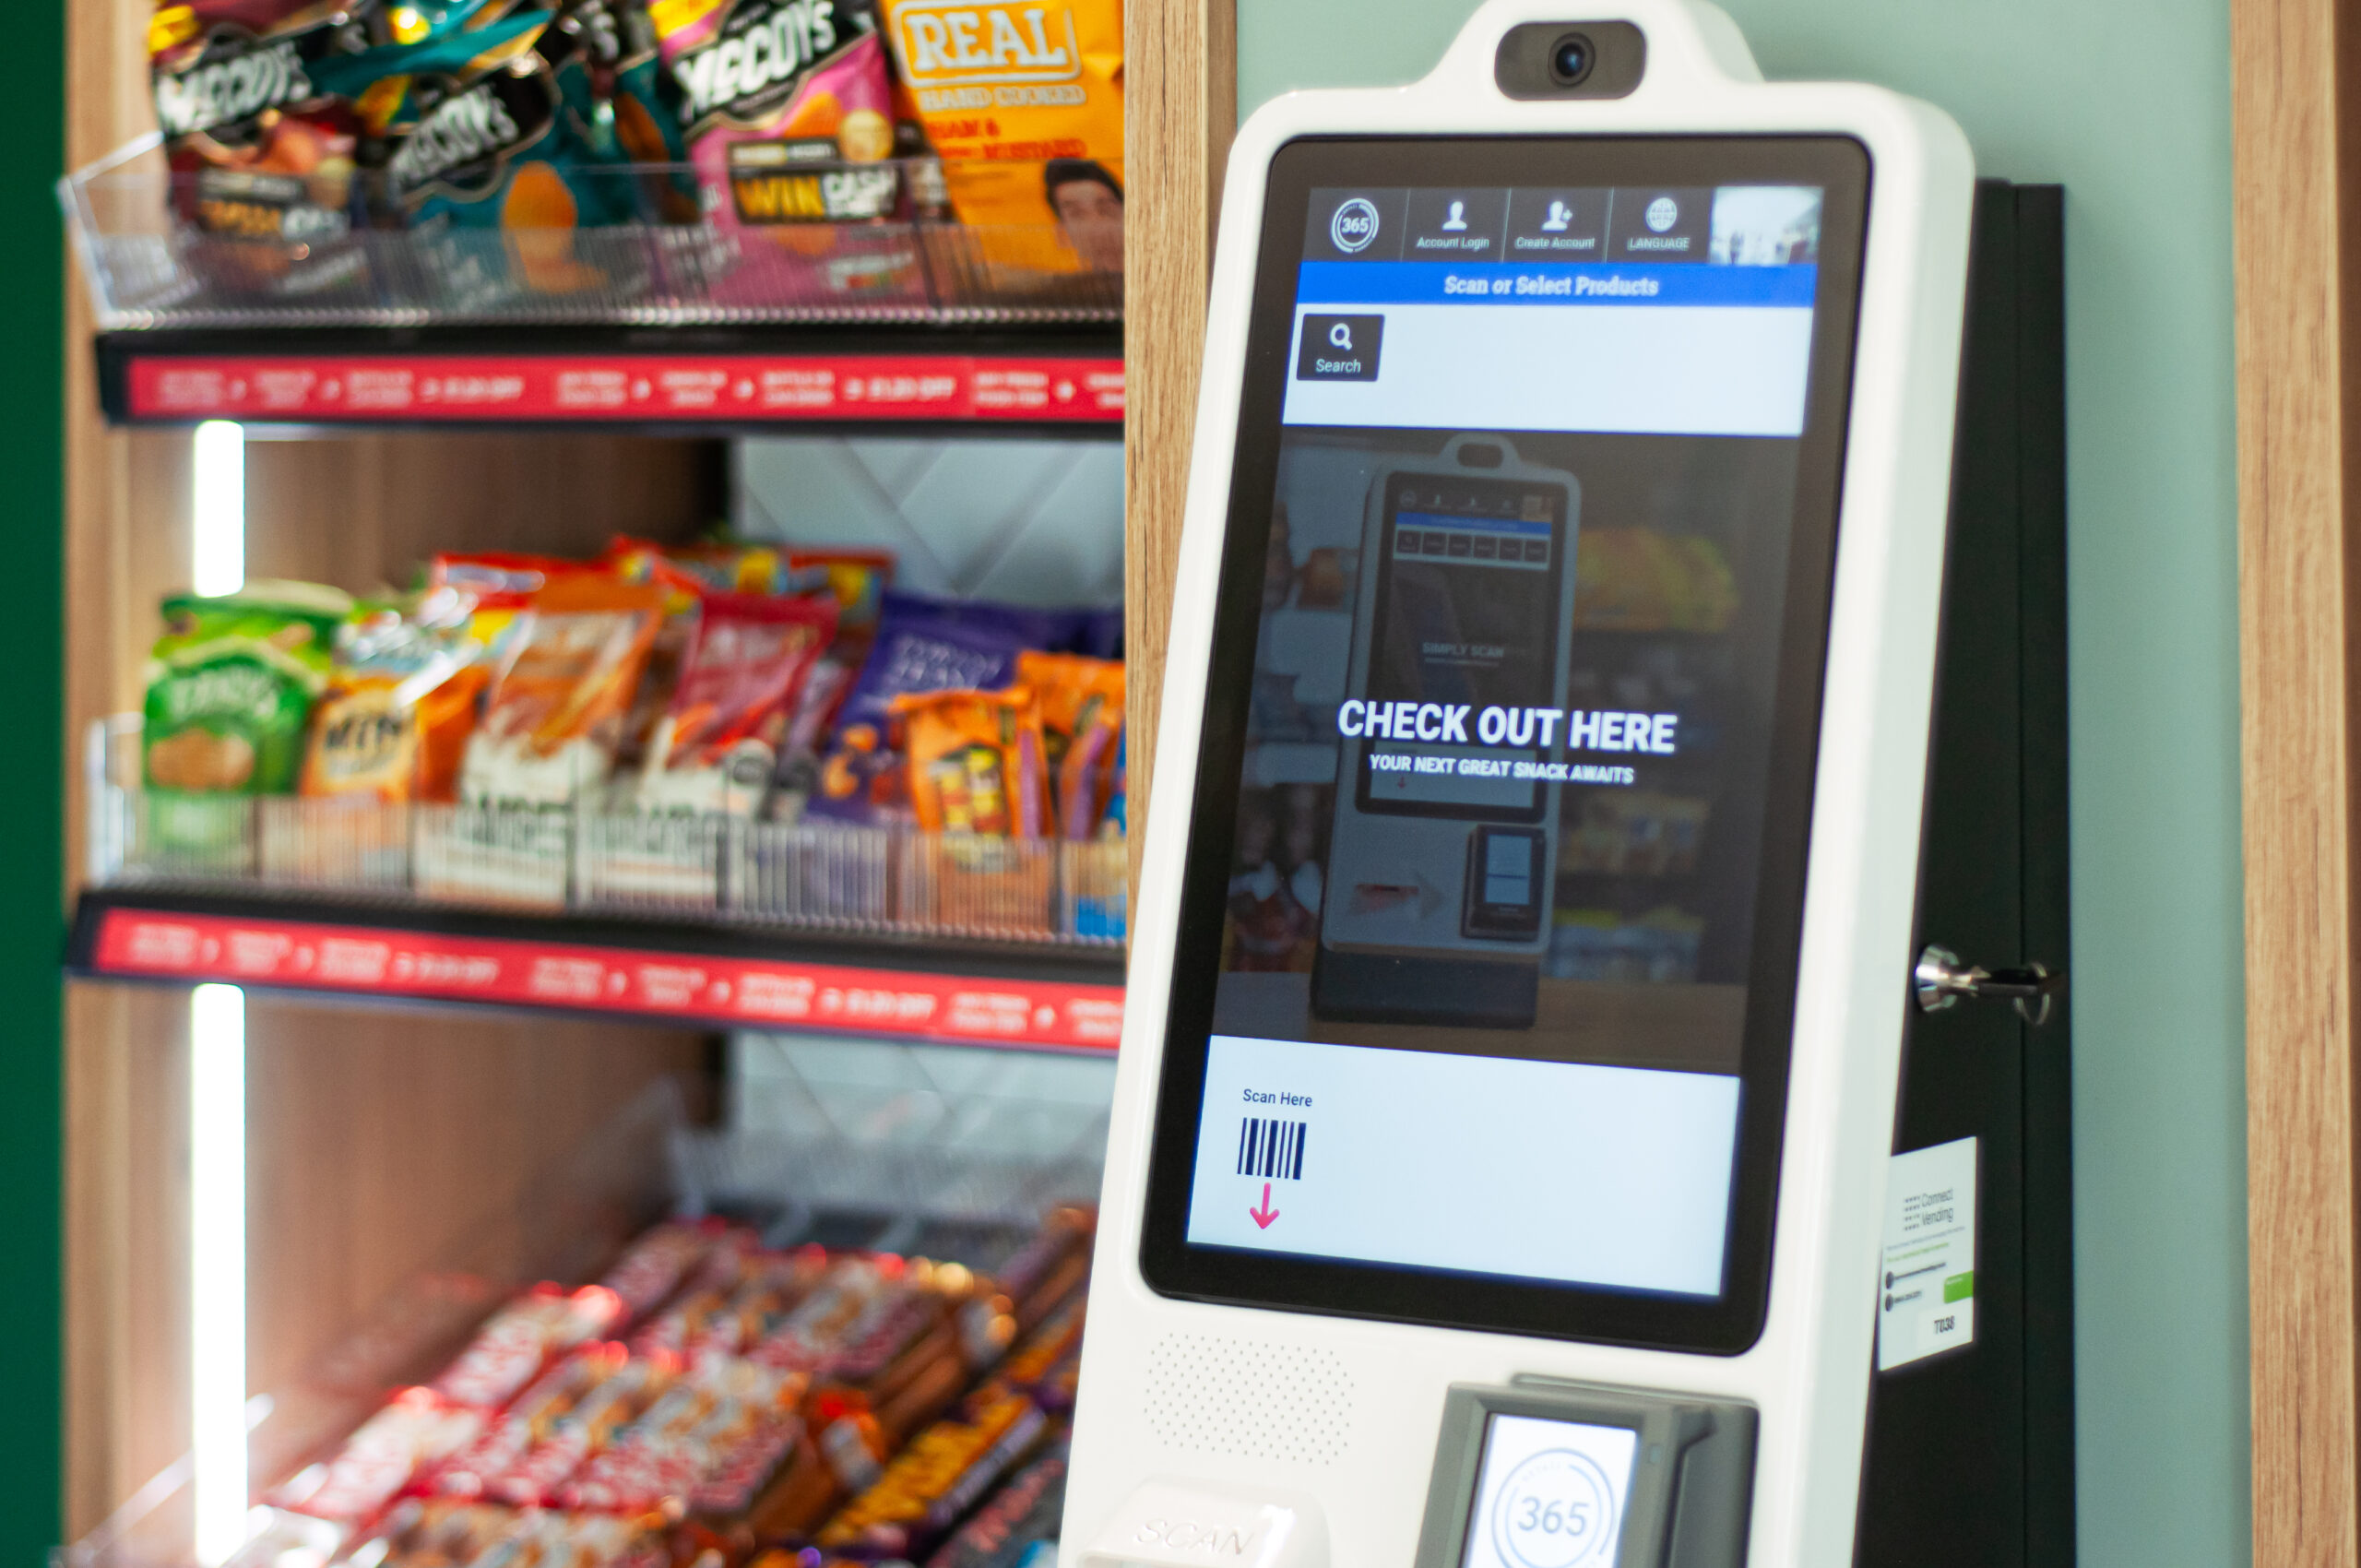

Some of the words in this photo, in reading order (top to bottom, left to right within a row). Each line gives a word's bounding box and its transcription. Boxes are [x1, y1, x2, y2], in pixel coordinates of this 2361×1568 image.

[905, 8, 1068, 71] REAL
[739, 175, 825, 217] WIN
[1342, 217, 1370, 233] 365
[1417, 236, 1459, 249] Account
[1461, 236, 1490, 252] Login
[1515, 236, 1550, 250] Create
[1551, 236, 1596, 250] Account
[1628, 236, 1690, 251] LANGUAGE
[1444, 275, 1489, 294] Scan
[1492, 278, 1513, 294] or
[1515, 275, 1572, 295] Select
[1575, 276, 1659, 296] Products
[1315, 358, 1361, 373] Search
[1338, 699, 1472, 742] CHECK
[1477, 706, 1563, 747] OUT
[1569, 709, 1679, 754] HERE
[1370, 754, 1412, 772] YOUR
[1413, 756, 1457, 775] NEXT
[1458, 758, 1513, 778] GREAT
[1513, 761, 1569, 780] SNACK
[1569, 764, 1635, 785] AWAITS
[1242, 1088, 1276, 1104] Scan
[1280, 1091, 1313, 1107] Here
[1921, 1188, 1953, 1207] Connect
[1922, 1206, 1954, 1226] Vending
[1518, 1495, 1590, 1537] 365
[1136, 1518, 1255, 1556] SCAN
